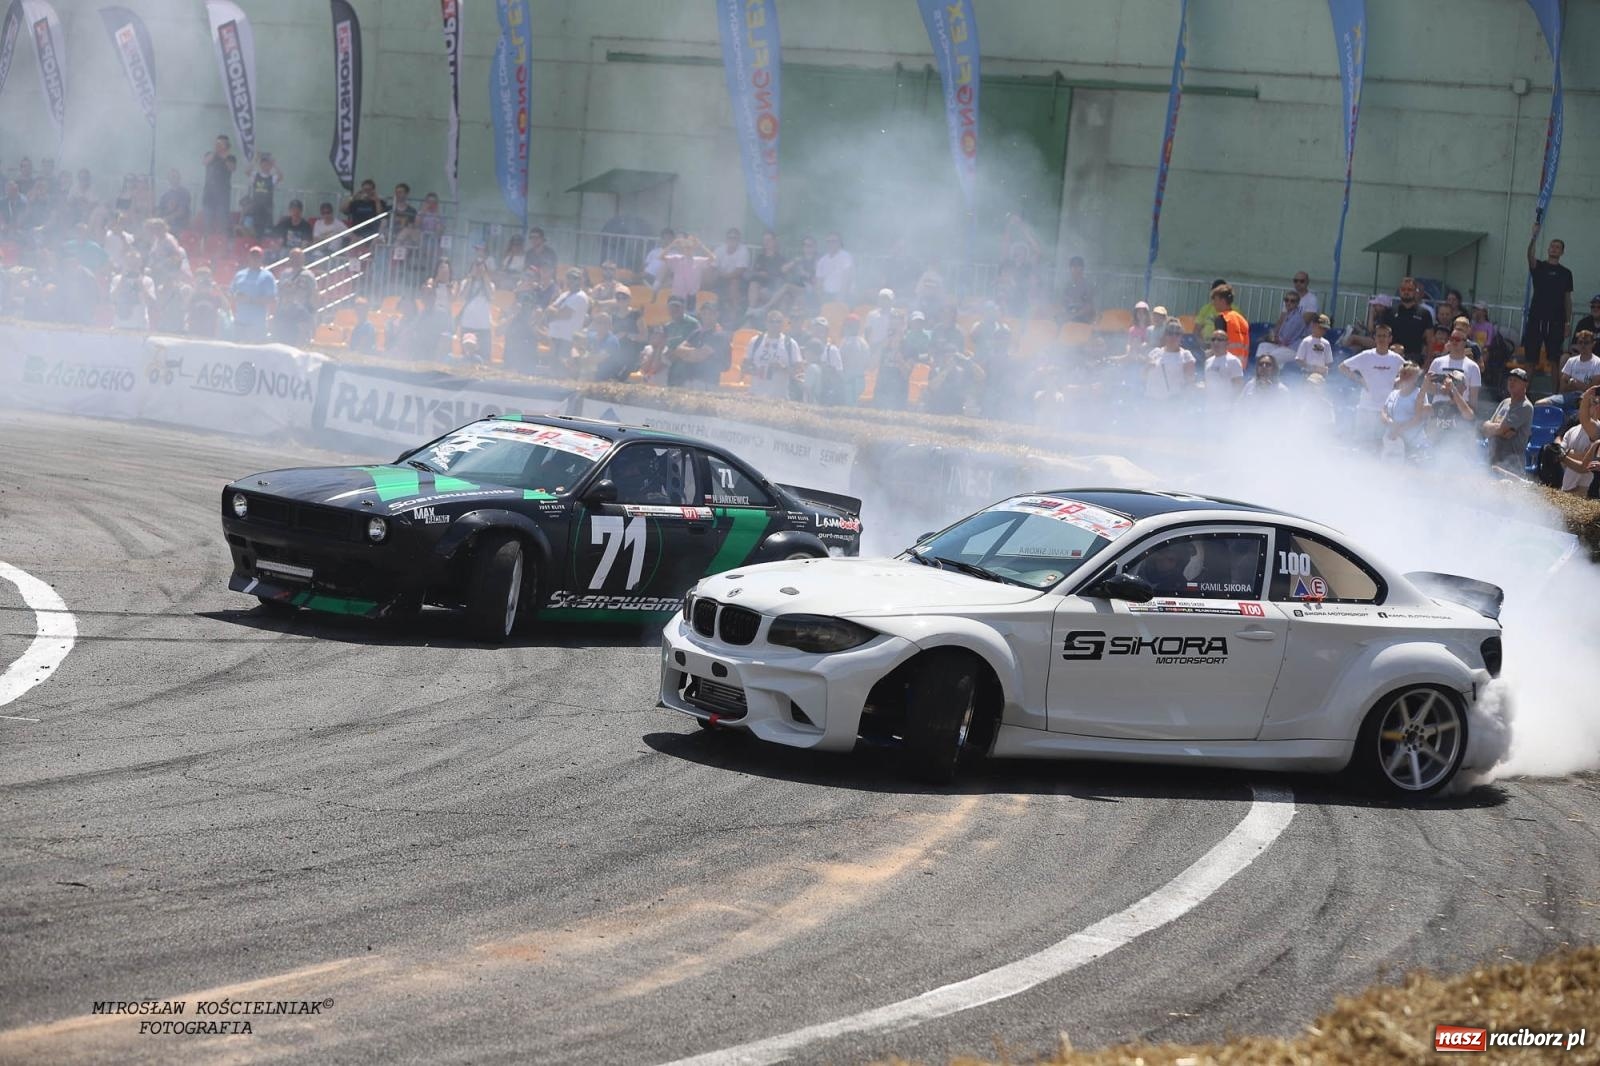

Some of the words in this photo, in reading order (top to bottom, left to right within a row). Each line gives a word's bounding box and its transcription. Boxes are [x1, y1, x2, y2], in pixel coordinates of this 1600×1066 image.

[718, 468, 735, 489] 71
[414, 507, 435, 520] MAX
[587, 515, 647, 591] 71
[1279, 551, 1311, 576] 100
[1200, 582, 1222, 592] KAMIL
[1224, 583, 1252, 592] SIKORA
[1243, 604, 1261, 616] 100
[1156, 657, 1228, 665] MOTORSPORT
